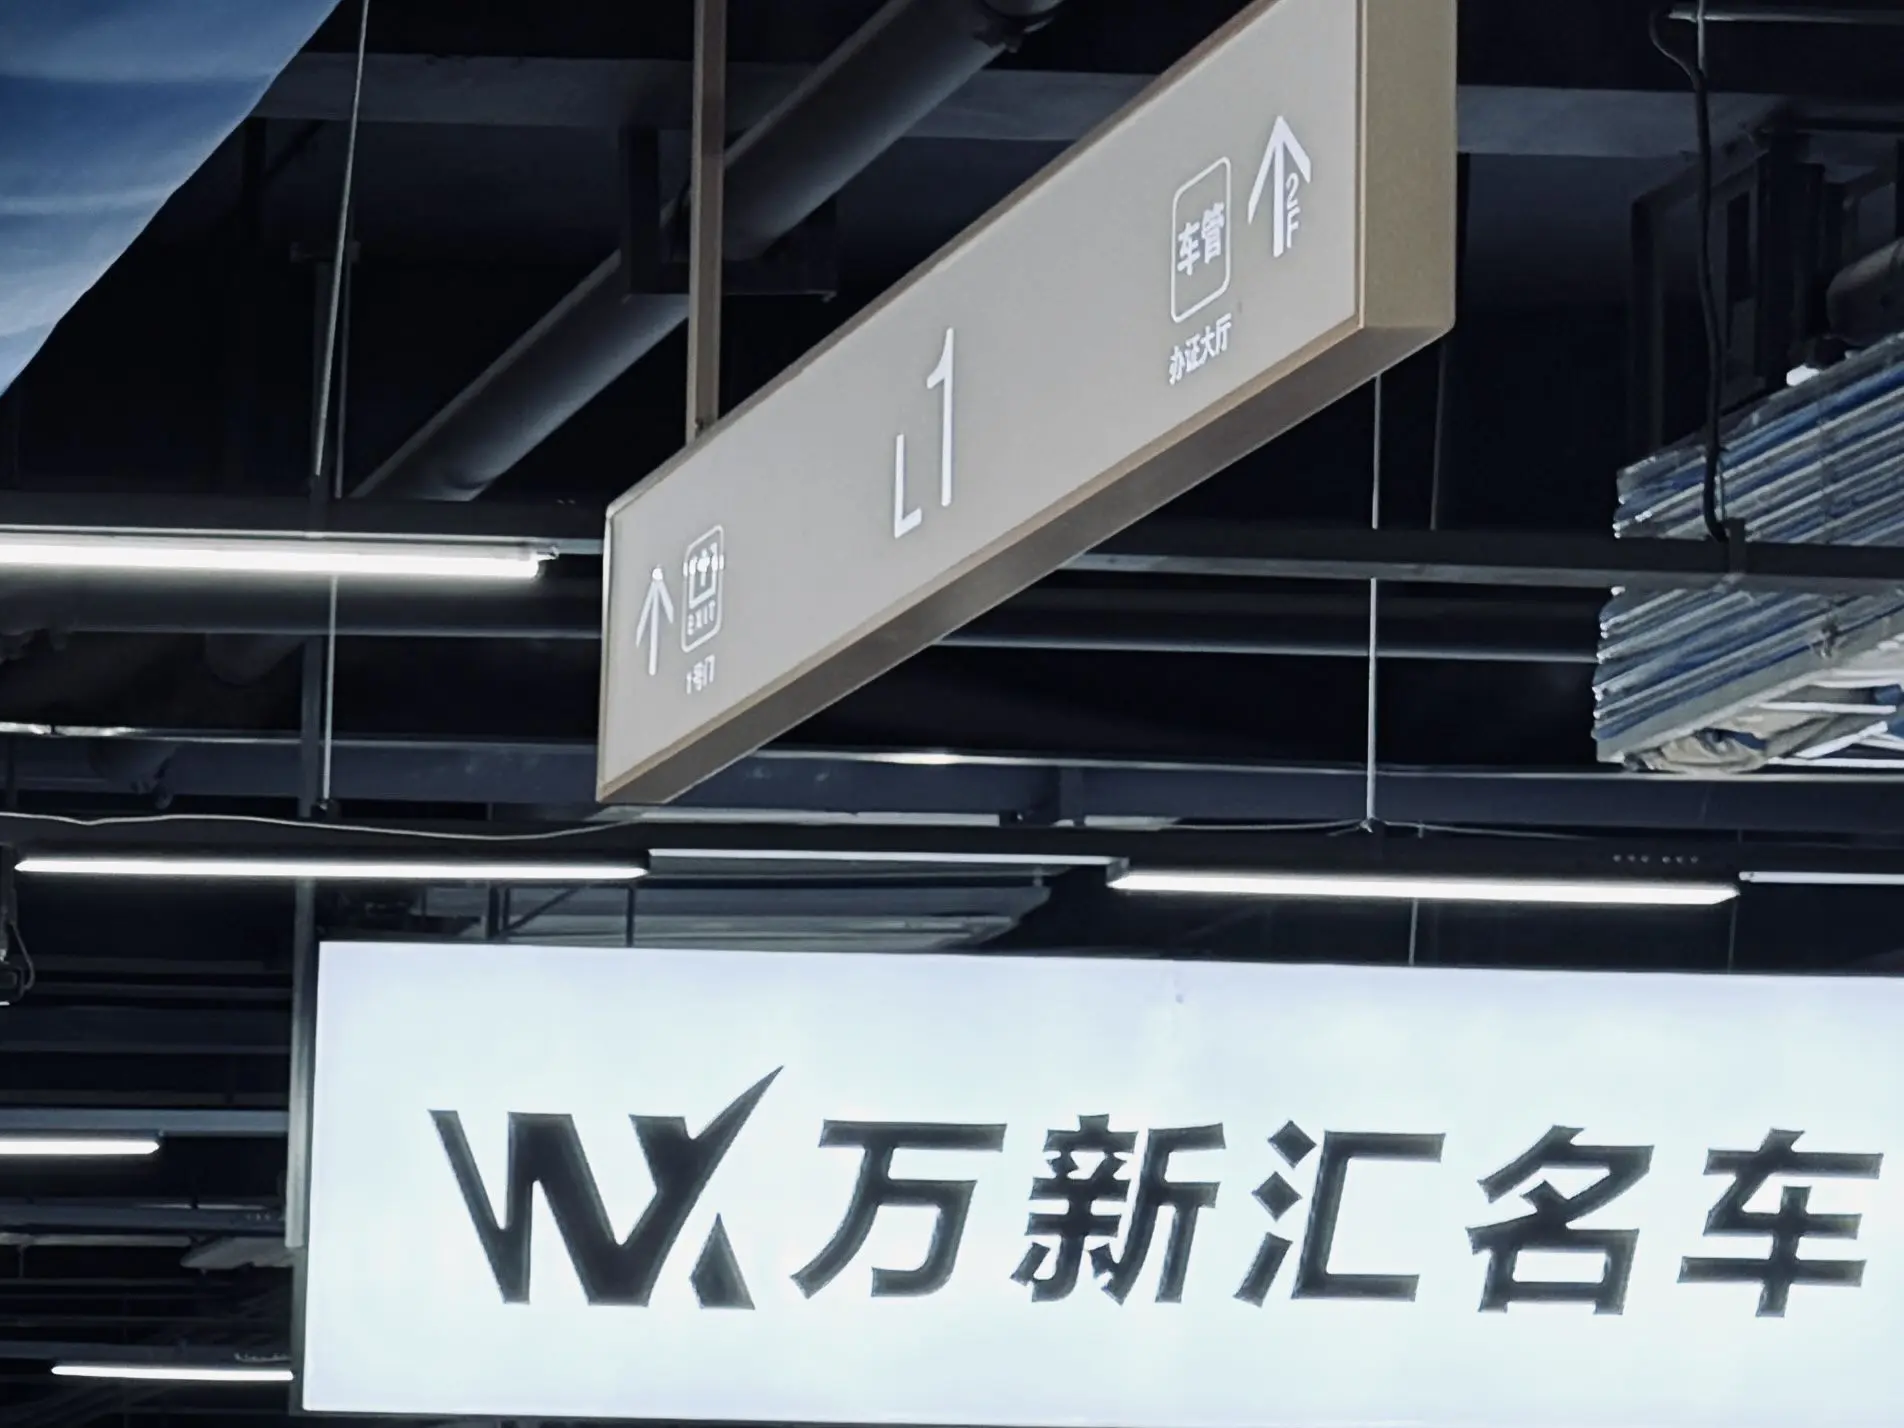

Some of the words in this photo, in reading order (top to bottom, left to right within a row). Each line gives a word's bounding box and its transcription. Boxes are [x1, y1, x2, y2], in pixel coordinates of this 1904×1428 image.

[1177, 201, 1225, 276] 车管
[1168, 312, 1232, 385] 办证大厅
[893, 327, 955, 540] L1
[790, 1113, 1884, 1318] 万新汇名车
